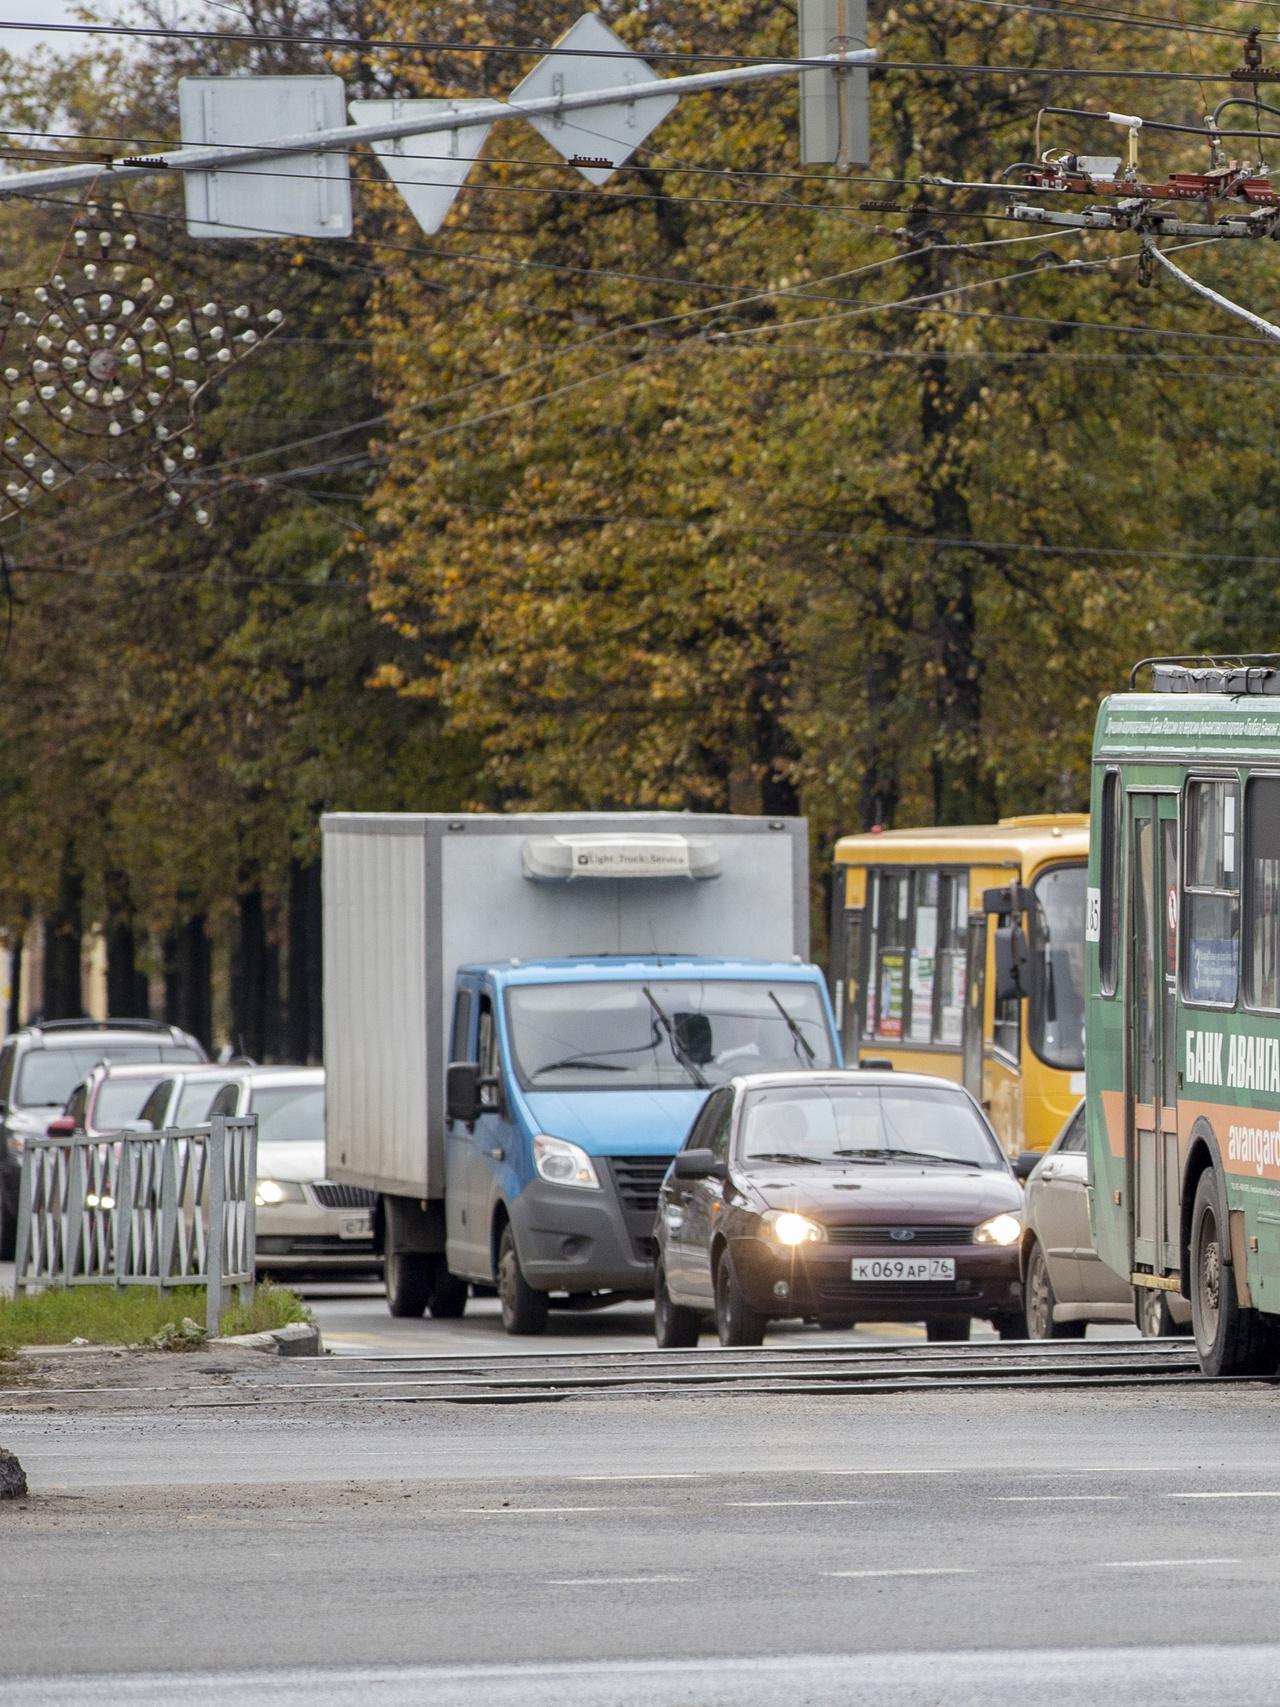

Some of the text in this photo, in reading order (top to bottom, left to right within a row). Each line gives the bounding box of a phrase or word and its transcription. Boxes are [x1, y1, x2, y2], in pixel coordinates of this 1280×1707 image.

[1186, 1030, 1223, 1086] БАНК
[859, 1261, 949, 1277] К069АР 76
